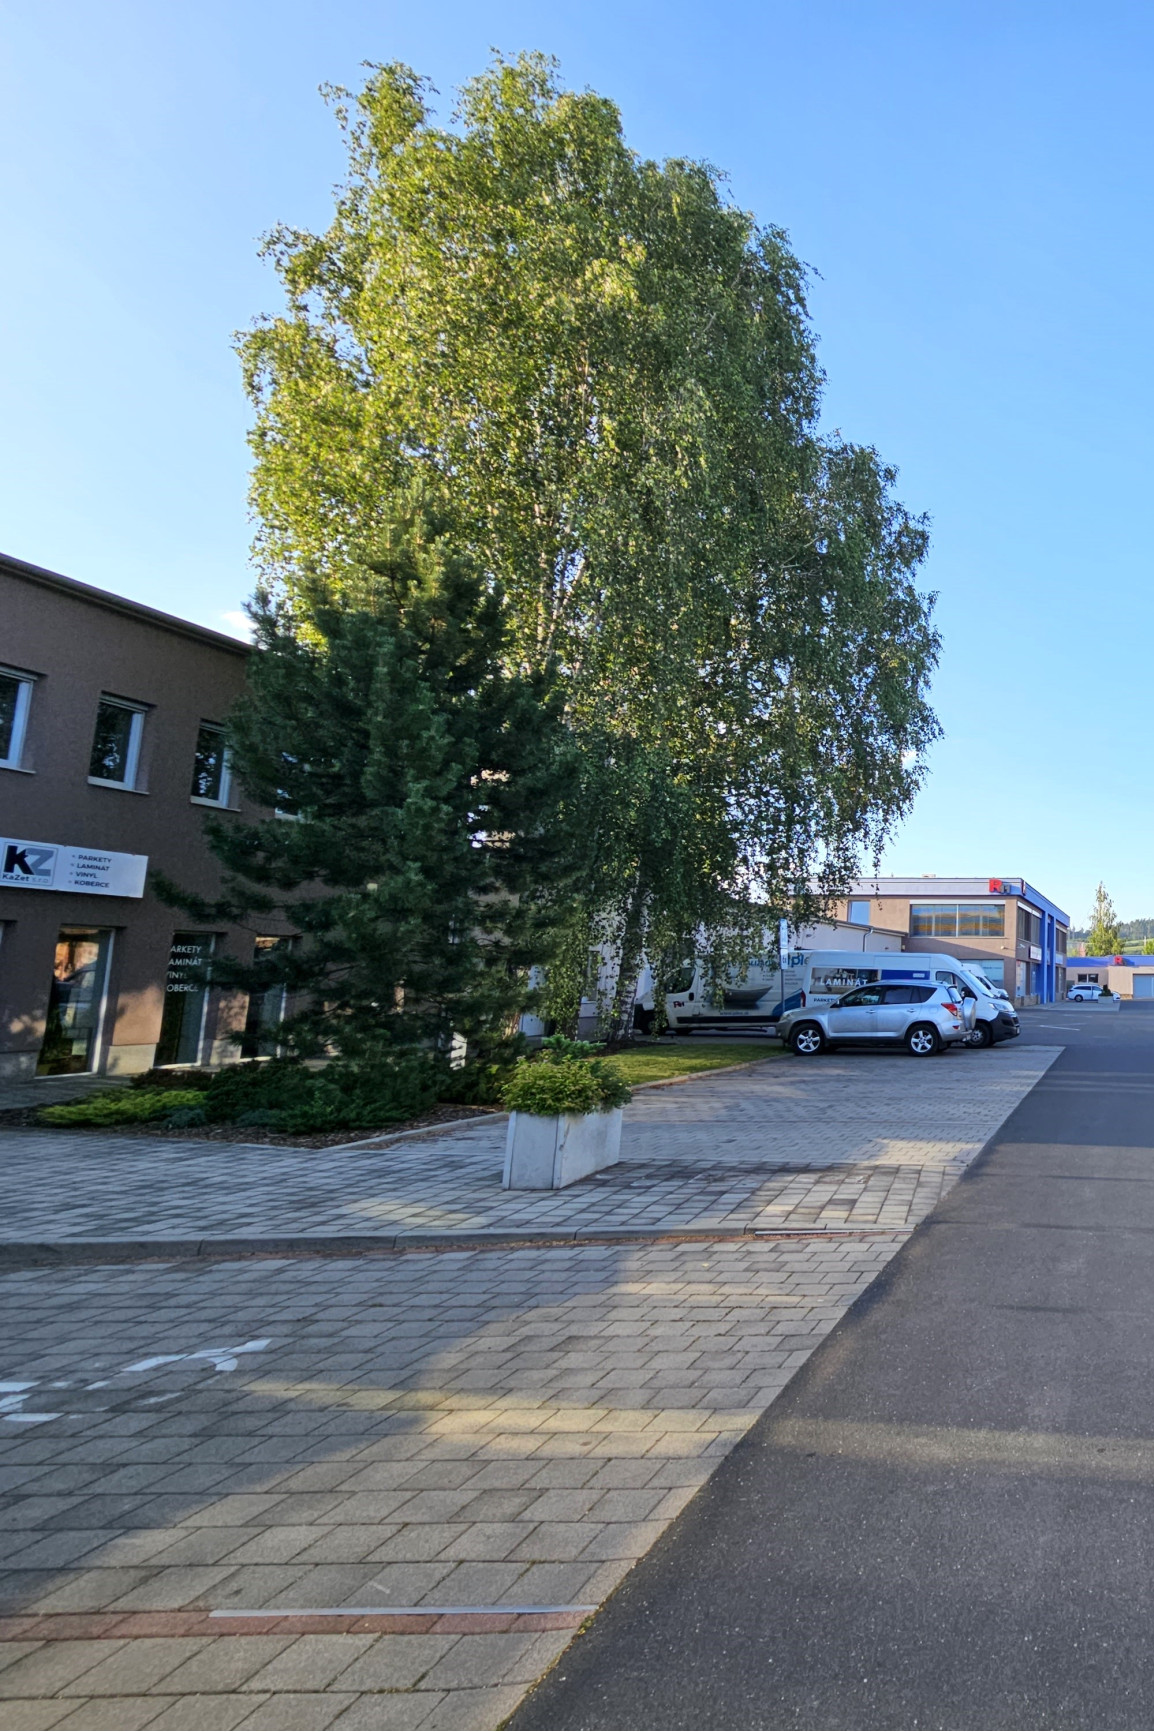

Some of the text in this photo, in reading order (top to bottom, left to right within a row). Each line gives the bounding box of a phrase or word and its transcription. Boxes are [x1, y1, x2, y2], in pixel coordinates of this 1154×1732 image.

[78, 854, 112, 863] PARKETY
[2, 873, 30, 882] KaZet
[75, 871, 99, 879] VINYL
[74, 879, 111, 888] KOBERCE
[170, 945, 202, 953] ARKETY
[167, 955, 203, 966] AMINÁT
[820, 976, 869, 987] LAMINÁT
[166, 983, 200, 992] OBERCE
